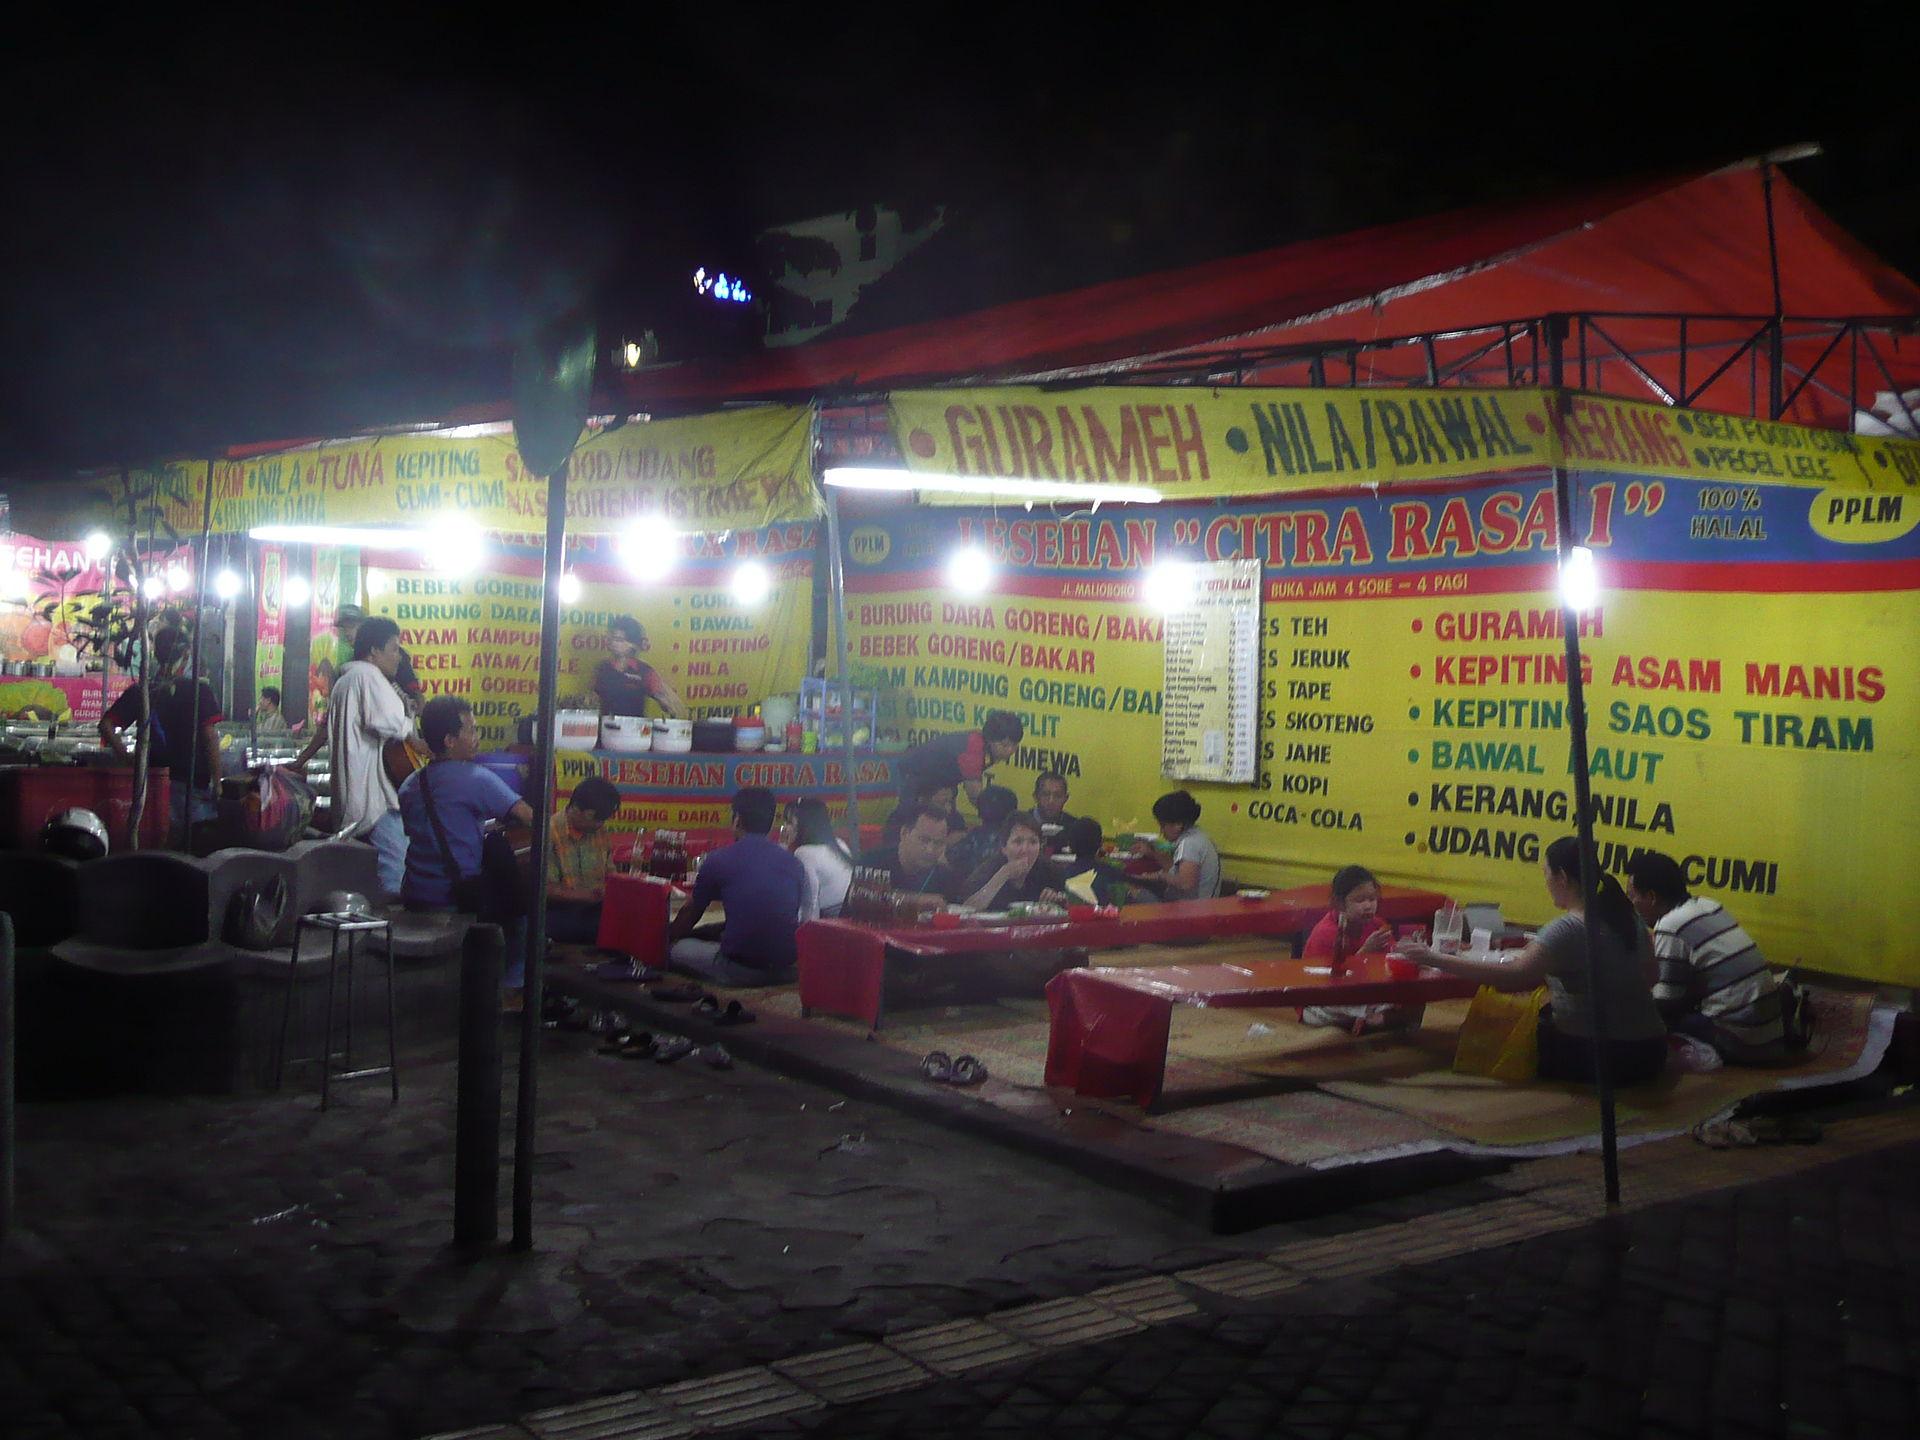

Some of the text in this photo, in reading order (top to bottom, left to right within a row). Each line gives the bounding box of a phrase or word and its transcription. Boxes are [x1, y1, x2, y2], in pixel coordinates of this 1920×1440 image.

[944, 403, 1211, 484] GURAMEH
[1250, 396, 1533, 476] NILA/BAWAL
[319, 450, 384, 492] TUNA
[395, 448, 481, 481] KEPITING
[1386, 488, 1558, 562] RASA
[1827, 496, 1904, 526] PPLM
[1690, 515, 1768, 541] HALAL
[396, 577, 462, 596] BEBEK
[1271, 582, 1304, 598] BUKA
[1309, 581, 1337, 597] JAM
[1359, 577, 1393, 595] SORE
[1434, 573, 1468, 592] PAGI
[396, 603, 482, 621] BURUNG
[490, 604, 542, 625] DARA
[690, 615, 754, 632] BAWAL
[860, 601, 933, 626] BURUNG
[941, 602, 996, 630] DARA
[1290, 616, 1328, 637] TEH
[399, 628, 458, 645] AYAM
[688, 633, 771, 653] KEPITING
[858, 632, 1097, 675] BEBEK GORENG/BAKAR
[1290, 649, 1351, 670] JERUK
[687, 661, 729, 677] NILA
[913, 666, 1009, 700] KAMPUNG
[1611, 654, 1722, 694] ASAM
[1744, 662, 1887, 705] MANIS
[686, 684, 749, 700] UDANG
[1287, 680, 1332, 702] TAPE
[905, 697, 966, 724] GUDEG
[1284, 711, 1375, 735] SKOTENG
[1607, 699, 1713, 742] SAOS
[1733, 709, 1875, 754] TIRAM
[1285, 743, 1332, 764] JAHE
[1431, 740, 1546, 776] BAWAL
[600, 759, 725, 788] LESEHAN
[734, 761, 817, 787] CITRA
[1282, 773, 1329, 797] KOPI
[1248, 800, 1364, 832] COCA-COLA
[1591, 792, 1676, 836] NILA
[1427, 824, 1541, 864] UDANG
